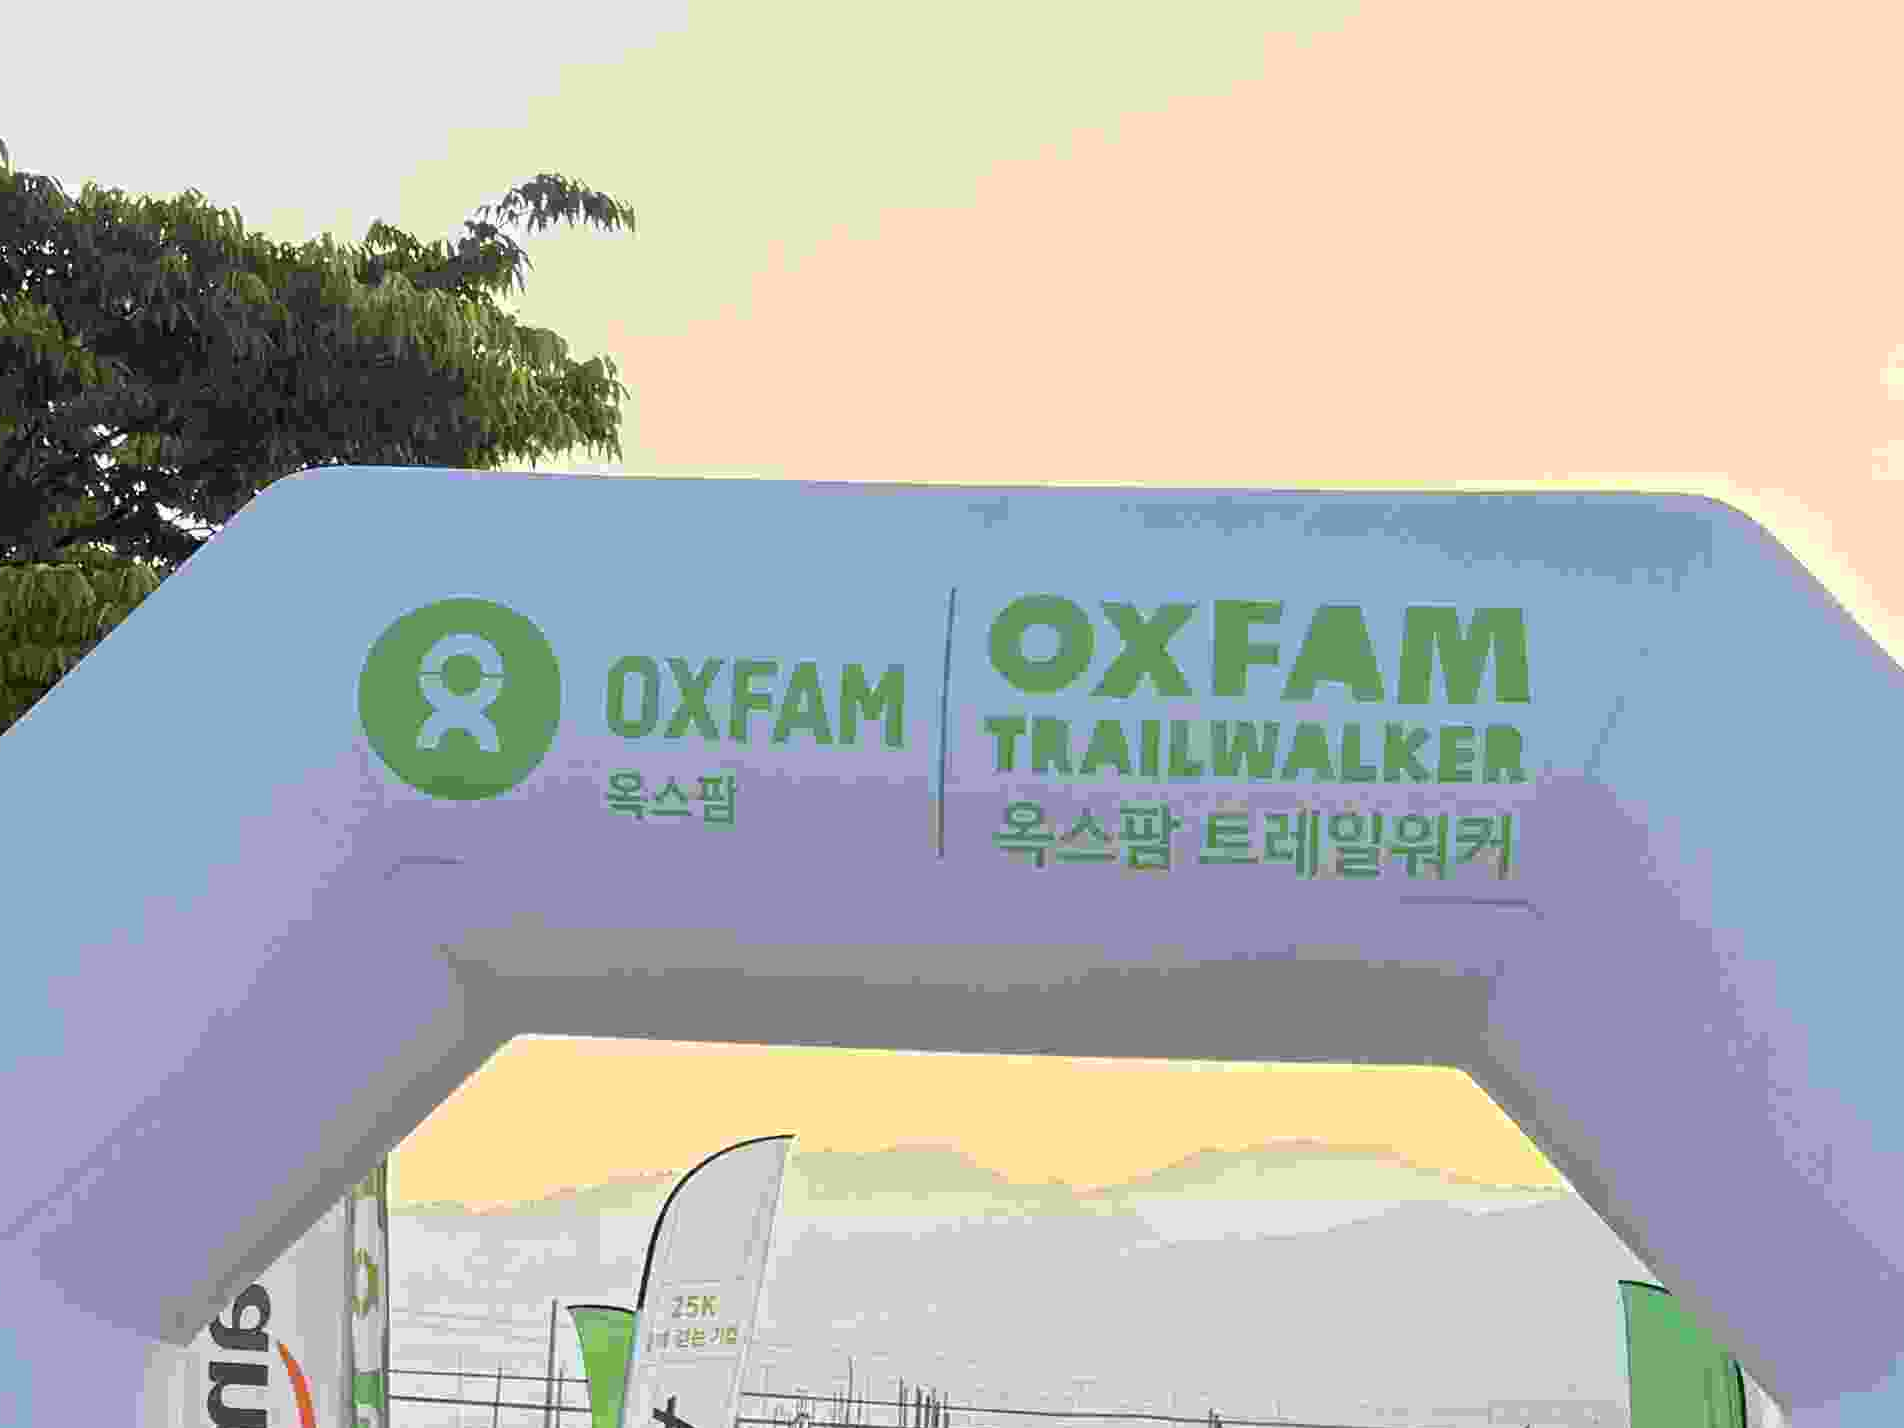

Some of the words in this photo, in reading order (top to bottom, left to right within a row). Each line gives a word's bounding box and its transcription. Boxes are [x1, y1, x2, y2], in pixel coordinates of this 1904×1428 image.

[985, 593, 1533, 706] OXFAM
[605, 656, 906, 749] OXFAM
[983, 712, 1529, 785] TRAILWALKER
[605, 771, 739, 826] 옥스팜
[992, 800, 1182, 874] 옥스팜
[1198, 804, 1515, 880] 트레일워커
